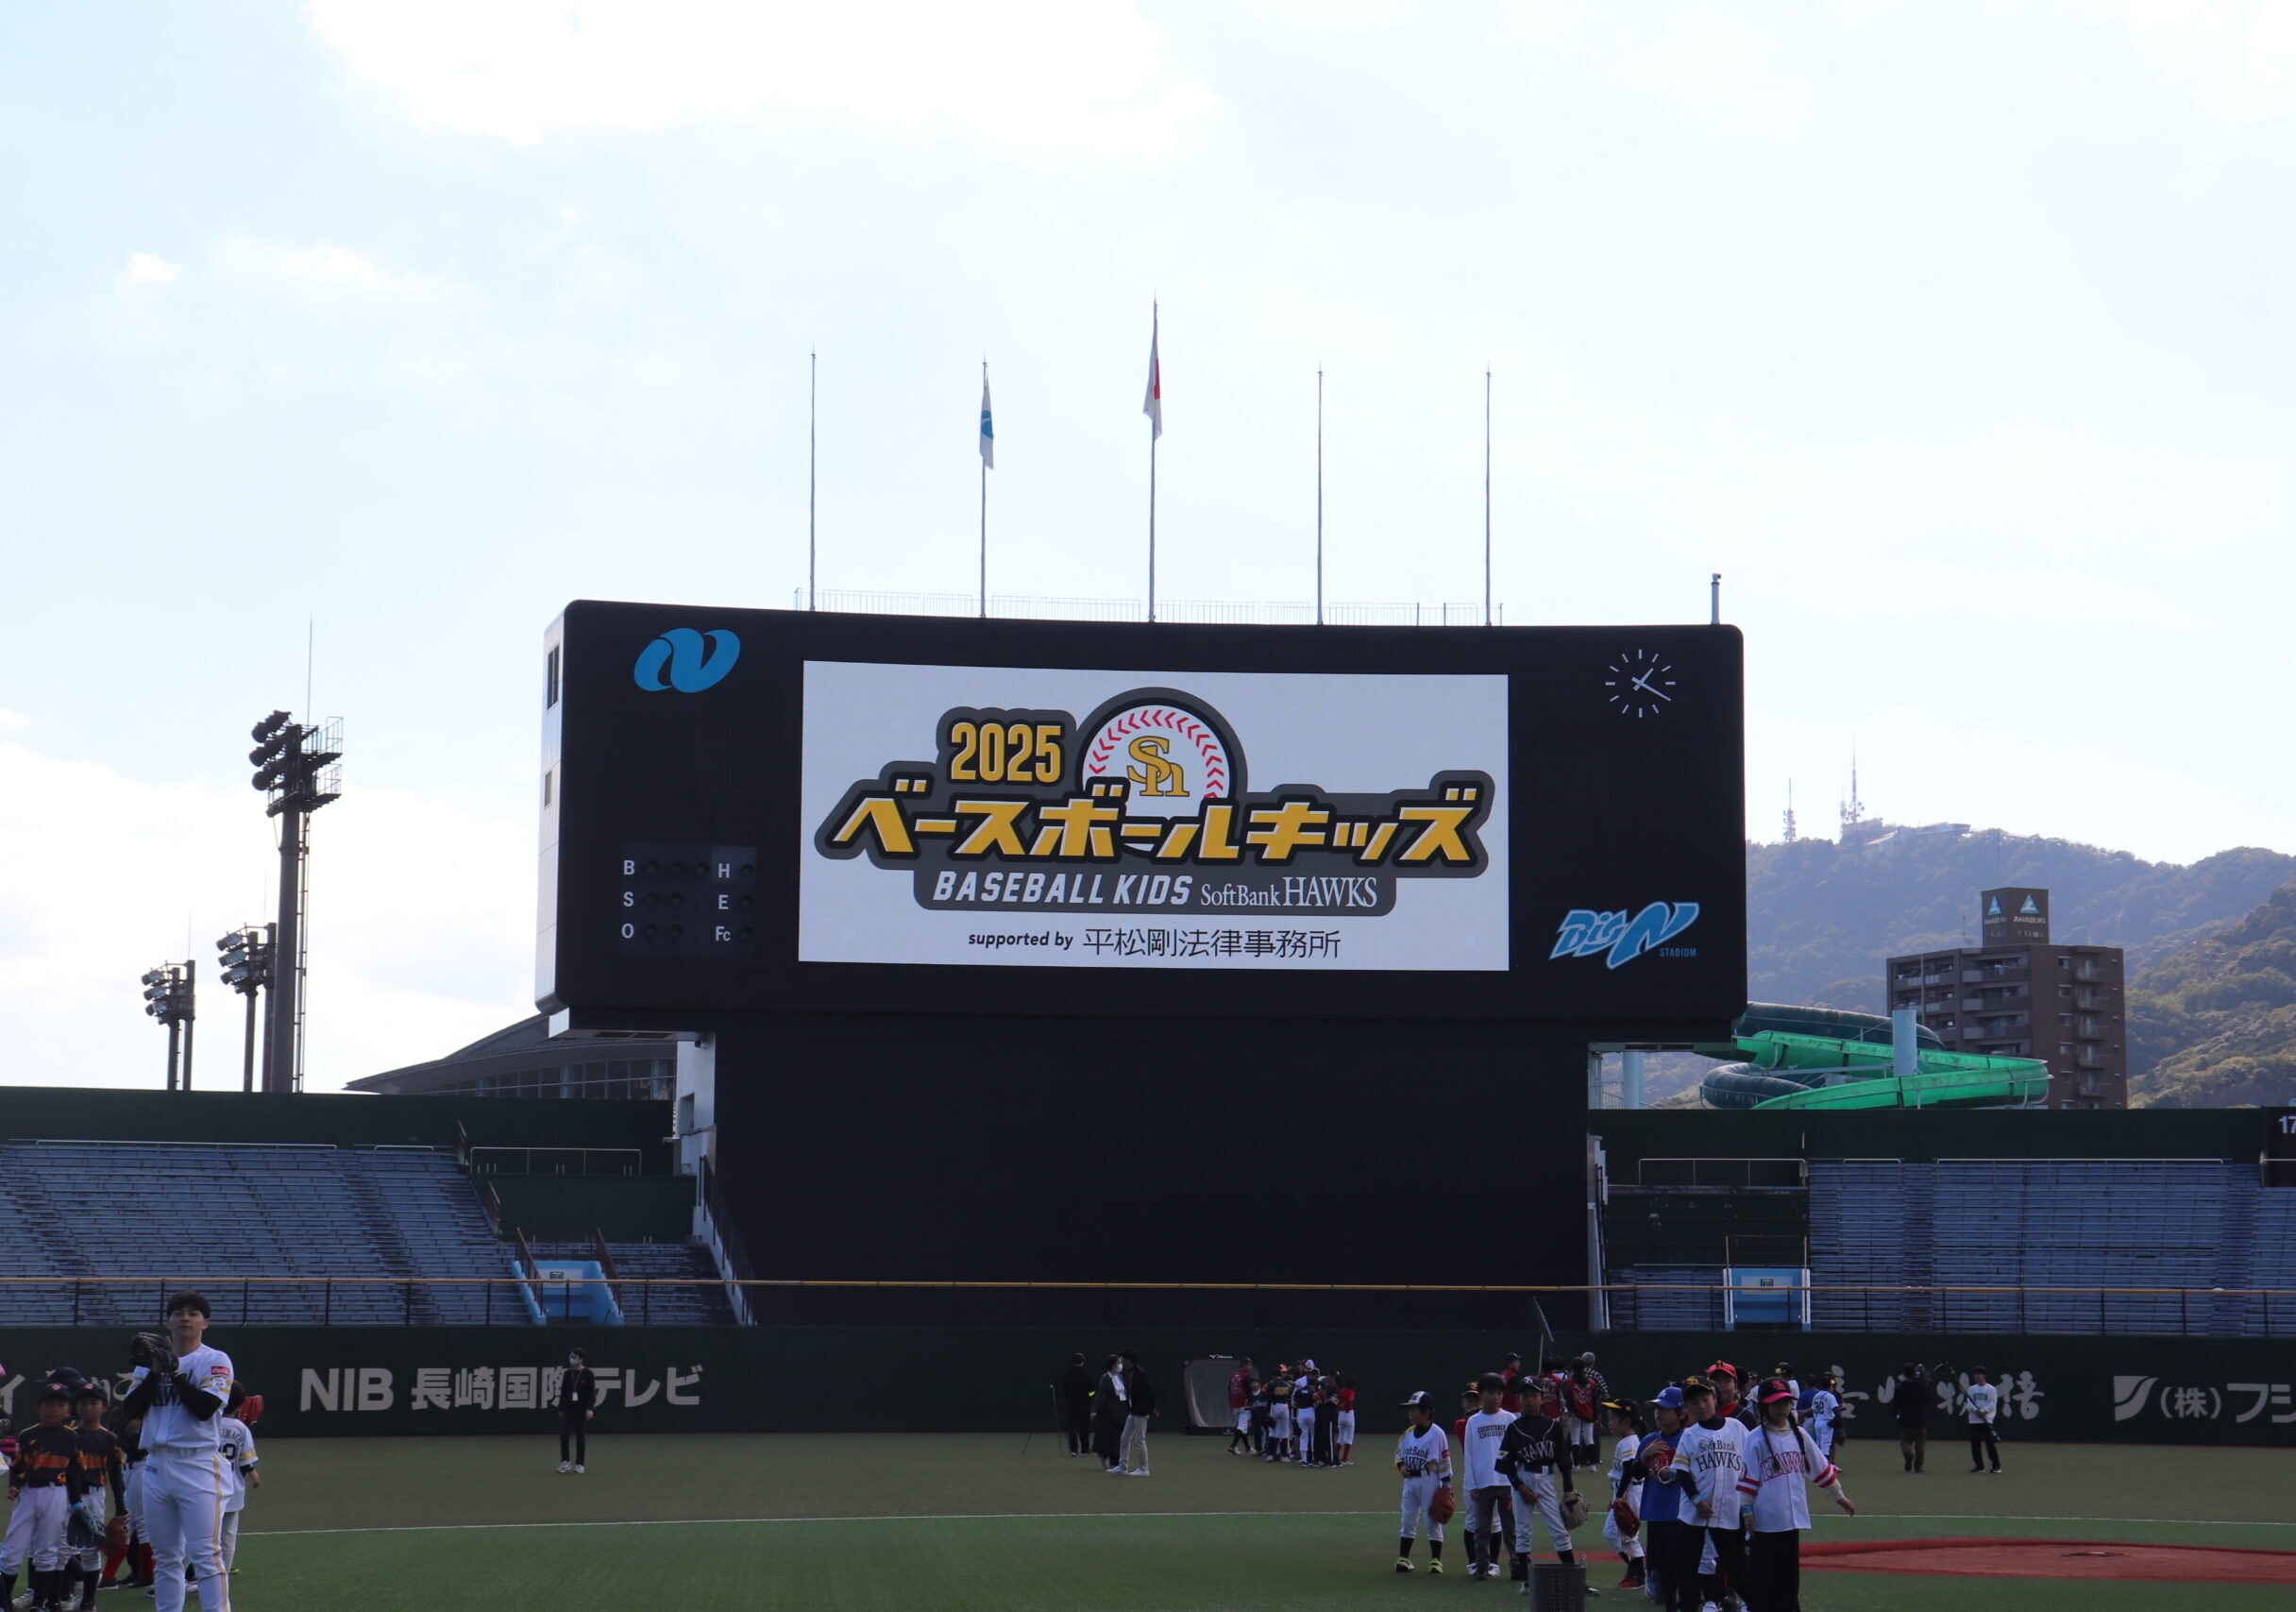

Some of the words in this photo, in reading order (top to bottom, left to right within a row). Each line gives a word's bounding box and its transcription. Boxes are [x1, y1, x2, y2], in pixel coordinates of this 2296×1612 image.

[950, 721, 1061, 783] 2025
[833, 778, 1477, 860] ベースボールキッズ
[623, 859, 635, 875] B
[718, 862, 731, 878] H
[622, 891, 634, 908] S
[933, 871, 1105, 904] BASEBALL
[1112, 874, 1193, 906] KIDS
[1200, 883, 1280, 908] SoftBank
[1282, 876, 1378, 908] HAWKS
[718, 894, 729, 910] E
[968, 931, 1050, 947] supported
[1054, 932, 1074, 950] by
[1082, 927, 1342, 959] 平松剛法律事務所
[1659, 947, 1697, 958] STADIUM
[300, 1367, 395, 1412] NIB
[1699, 1440, 1736, 1452] SoftBank
[1696, 1451, 1742, 1473] HAWKS
